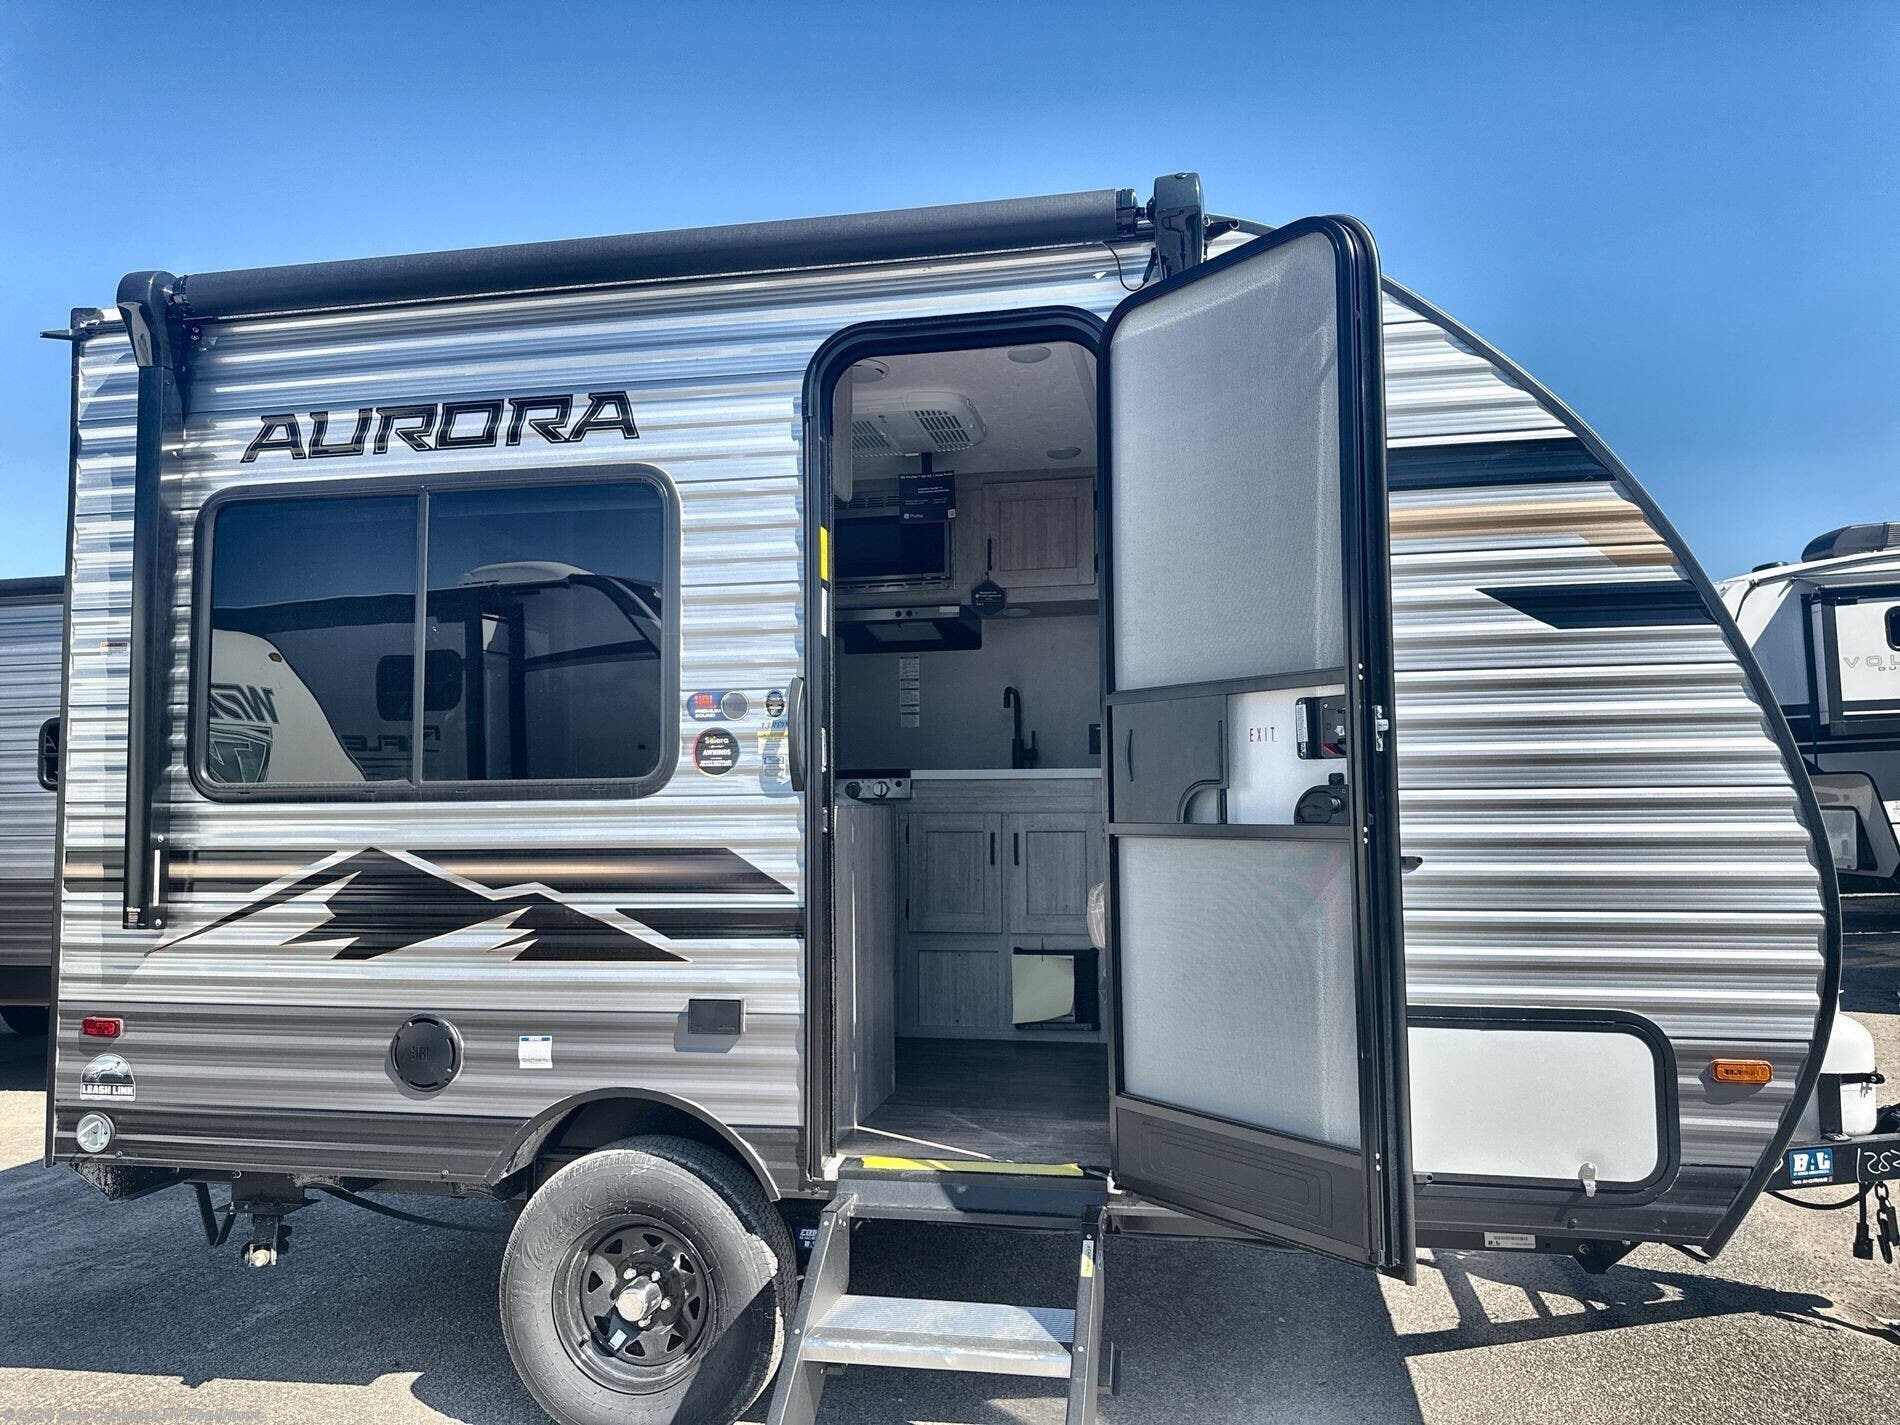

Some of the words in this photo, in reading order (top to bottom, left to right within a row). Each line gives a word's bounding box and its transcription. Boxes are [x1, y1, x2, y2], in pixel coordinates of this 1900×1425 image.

[240, 390, 640, 463] AURORA
[1249, 726, 1277, 742] EXIT
[82, 1084, 111, 1095] LEASH
[112, 1085, 134, 1096] LINK
